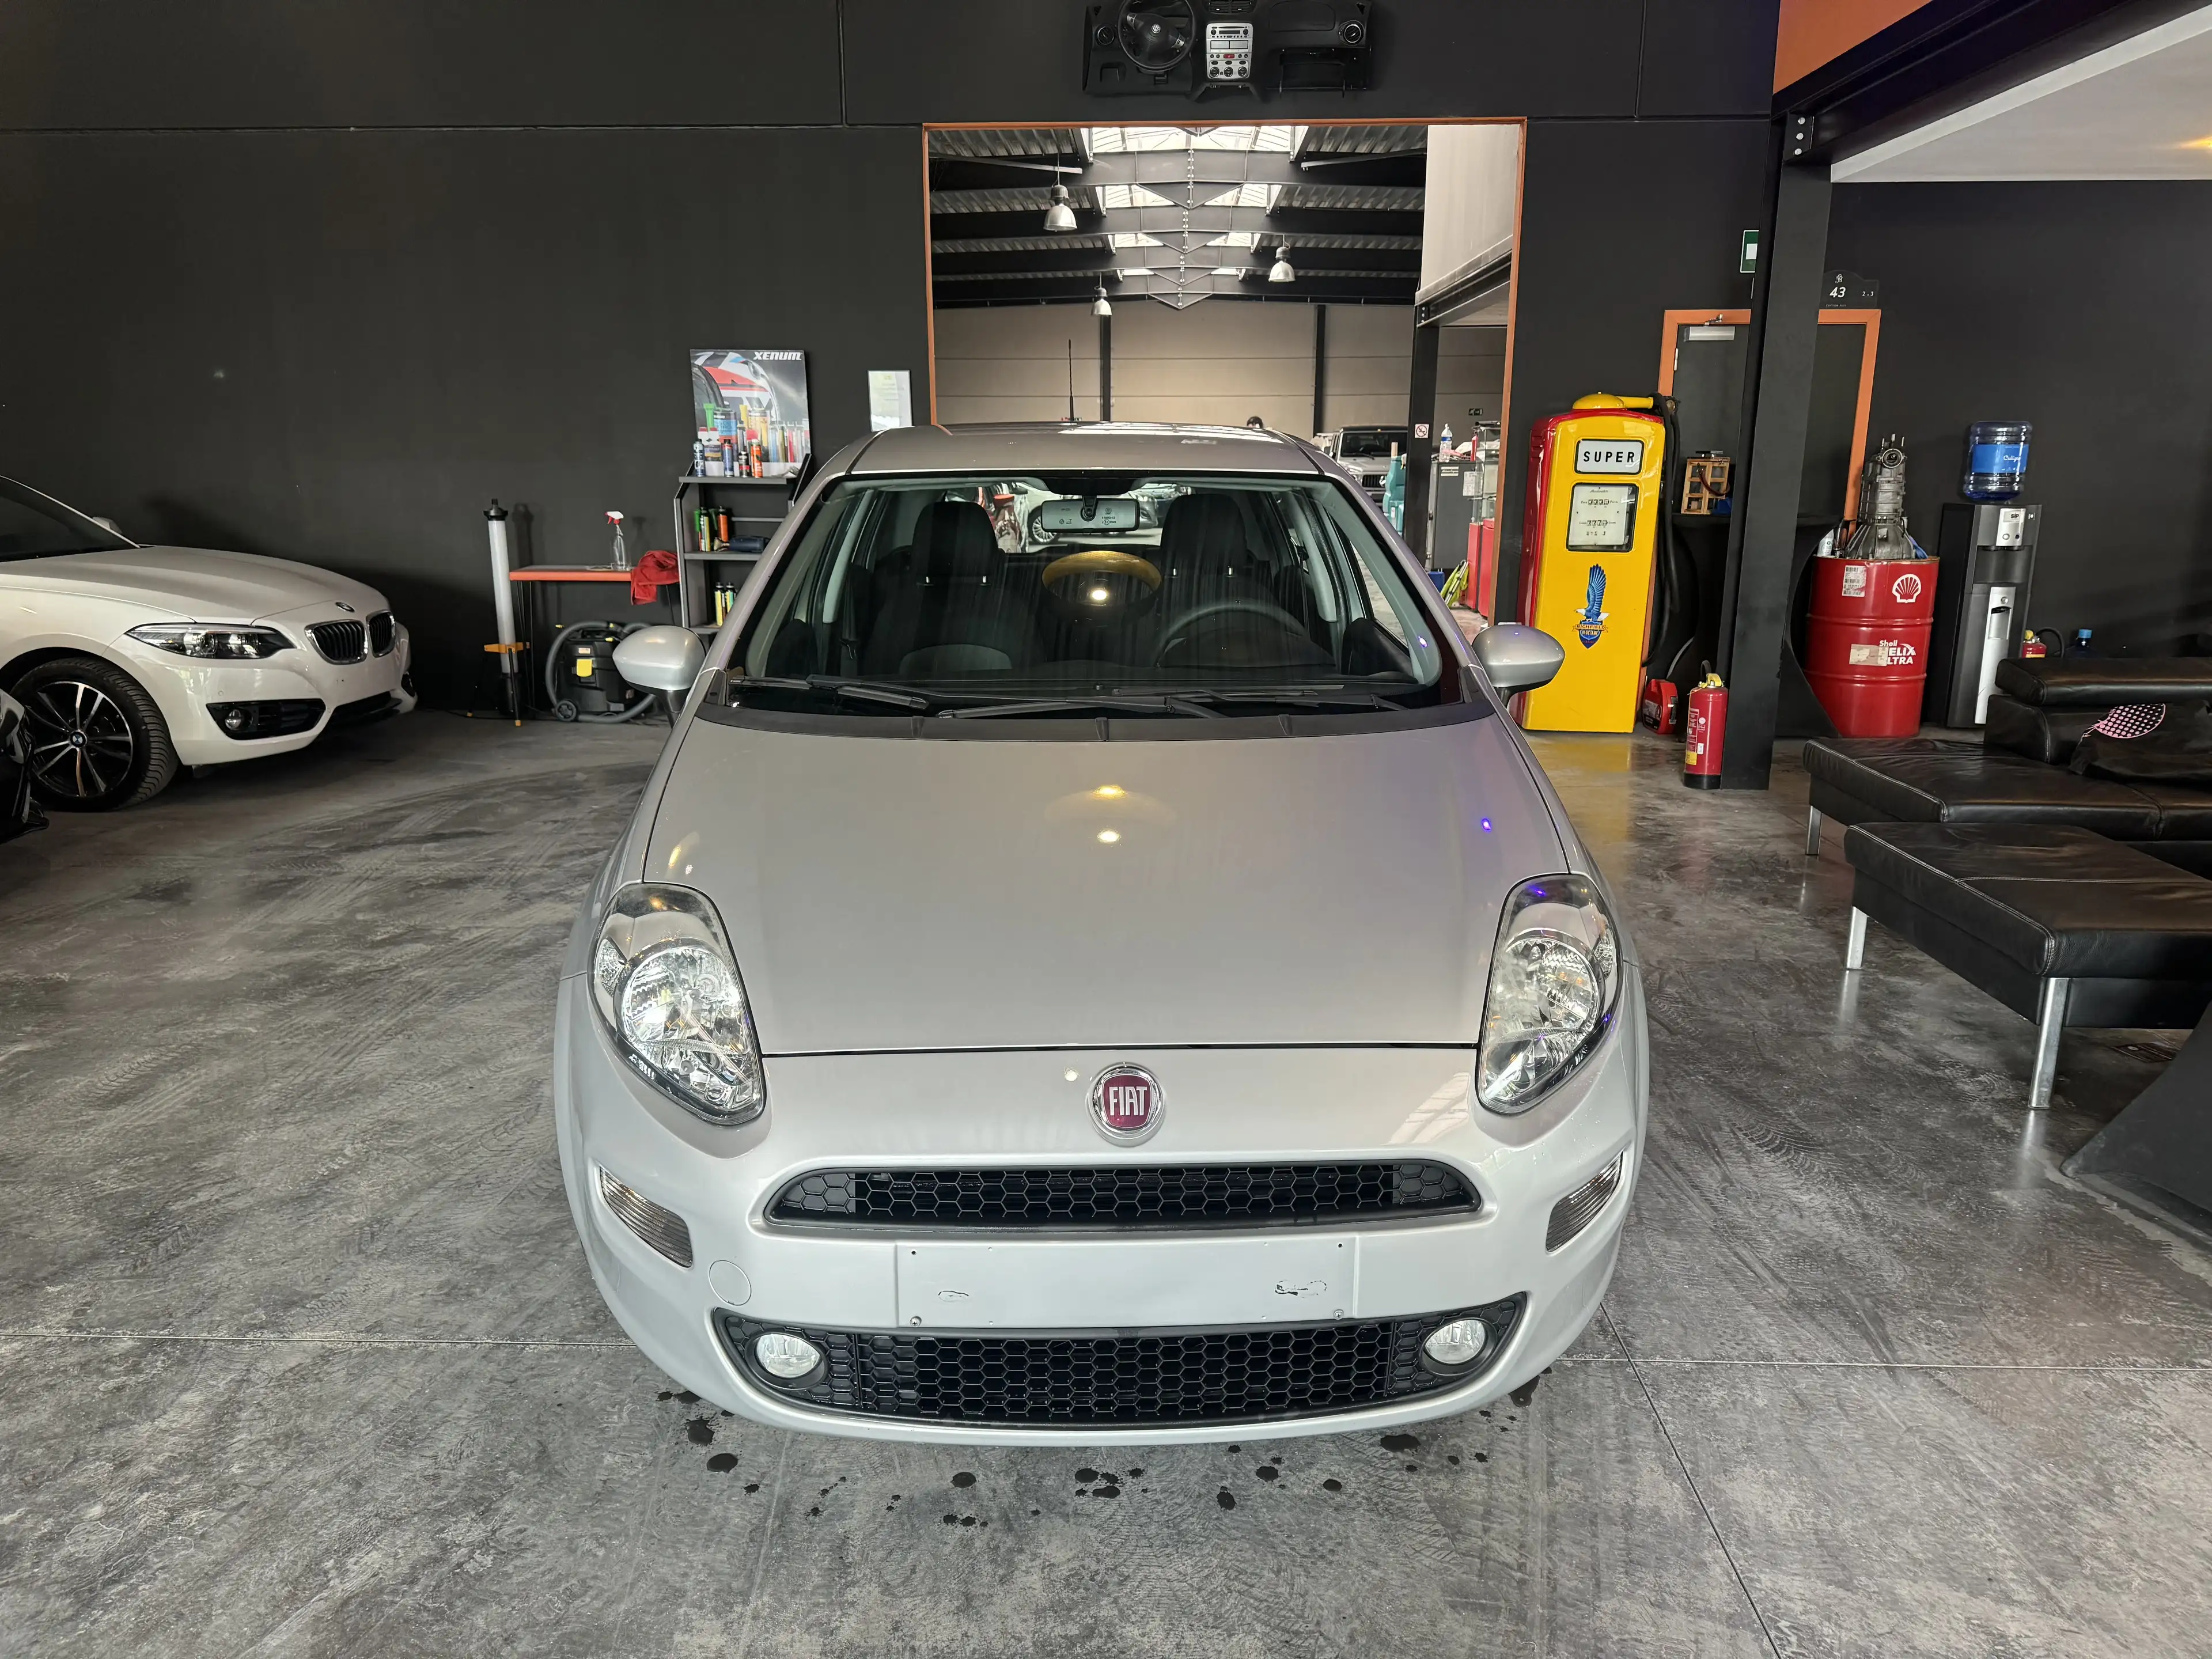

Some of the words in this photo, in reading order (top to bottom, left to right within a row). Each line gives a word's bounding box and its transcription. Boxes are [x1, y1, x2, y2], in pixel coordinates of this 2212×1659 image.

[1830, 286, 1846, 298] 43
[753, 351, 802, 361] XENUM
[1583, 451, 1635, 463] SUPER
[1879, 656, 1914, 665] LTRA
[1109, 1086, 1147, 1116] FIAT
